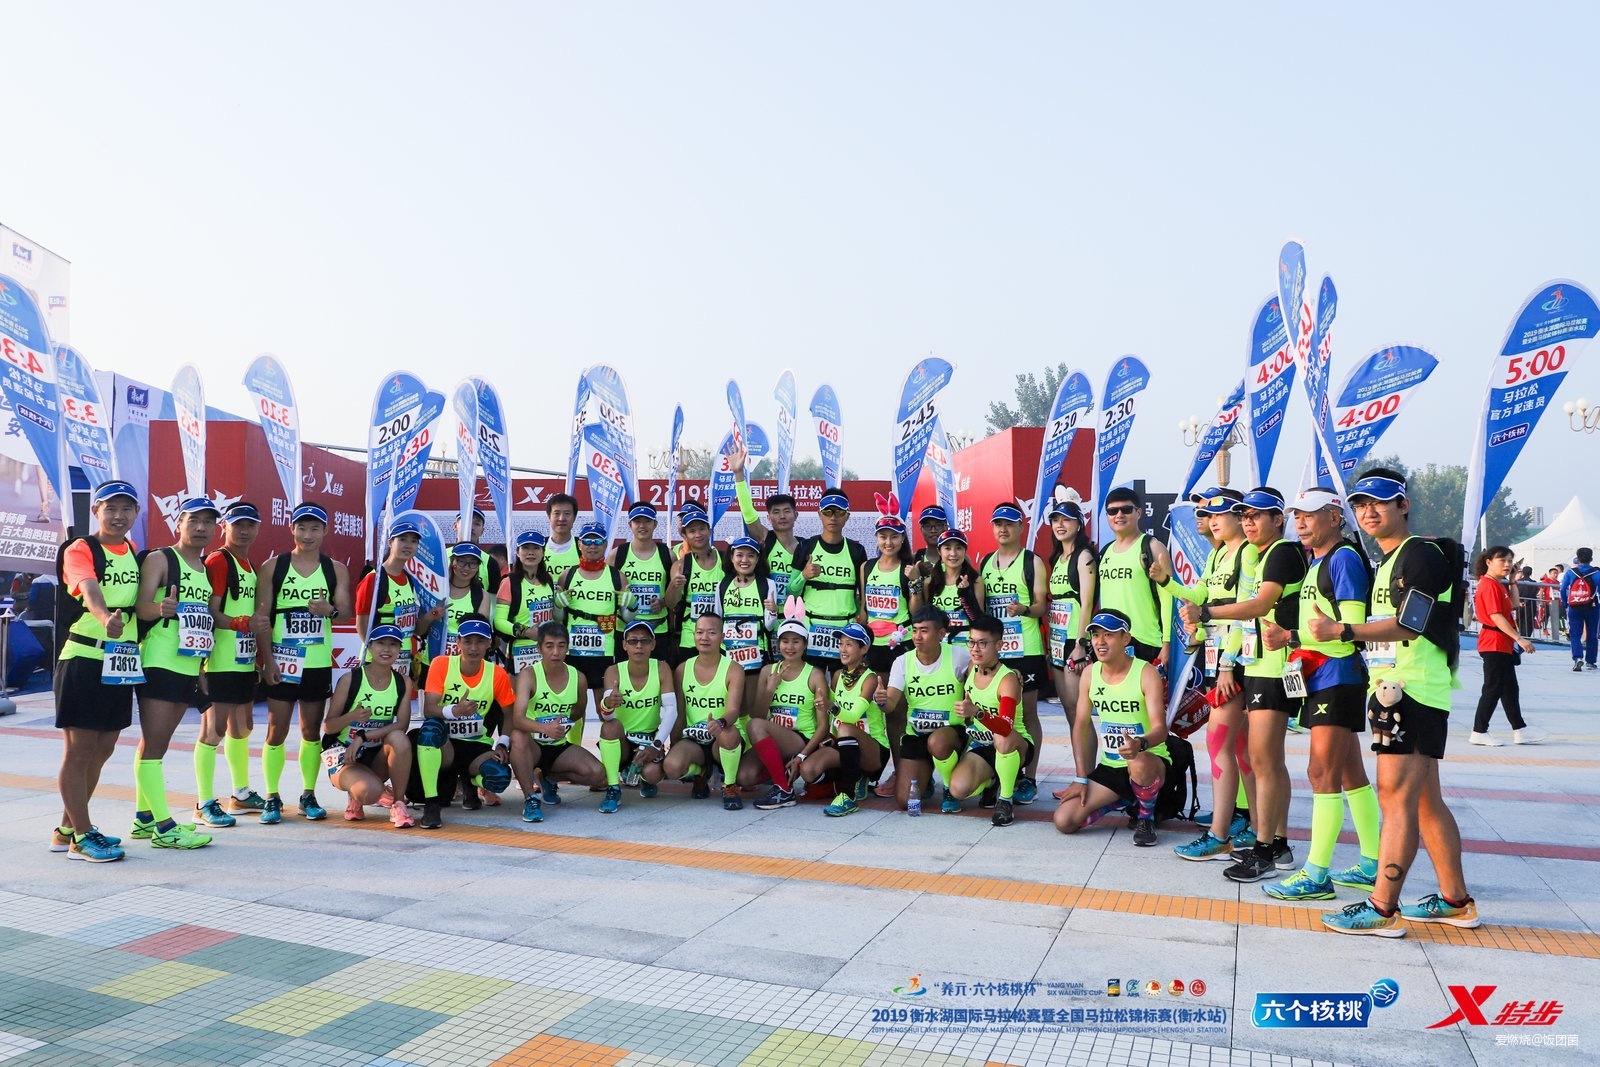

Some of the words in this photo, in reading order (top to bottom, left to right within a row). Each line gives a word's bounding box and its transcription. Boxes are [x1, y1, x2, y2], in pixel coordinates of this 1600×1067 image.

[1505, 345, 1566, 385] 5:00
[1259, 377, 1284, 402] 马拉松
[1502, 382, 1539, 404] 马拉松
[1104, 397, 1134, 430] 2:30
[1337, 394, 1401, 428] 4:00
[1489, 395, 1545, 421] 官方配速员
[901, 398, 935, 441] 2:45
[1051, 411, 1078, 439] 2:30
[378, 413, 411, 445] 2:00
[1335, 426, 1372, 445] 马拉松
[1492, 425, 1526, 444] 六个核桃
[770, 560, 793, 574] PAC
[819, 565, 852, 578] ACER
[1099, 567, 1133, 580] PACER
[624, 571, 663, 582] PACER
[1050, 574, 1069, 585] ACER
[238, 586, 256, 598] PAC
[282, 588, 329, 600] PACER
[690, 582, 719, 593] PACE
[986, 583, 1018, 594] ACER
[570, 590, 613, 602] PACER
[867, 597, 898, 610] 50526
[181, 614, 213, 630] 10406
[286, 620, 322, 634] 13807
[725, 629, 753, 639] 5:30
[185, 635, 213, 649] 3:30
[571, 635, 602, 648] 13816
[109, 655, 138, 672] 13812
[907, 683, 956, 698] PACER
[443, 693, 488, 710] PAER
[686, 697, 725, 709] PACER
[772, 693, 806, 705] ACER
[1093, 700, 1140, 713] PACER
[771, 715, 794, 728] 1079
[450, 721, 479, 739] 13811
[684, 728, 714, 741] 1380
[968, 728, 994, 742] 1380
[1103, 735, 1126, 749] 128
